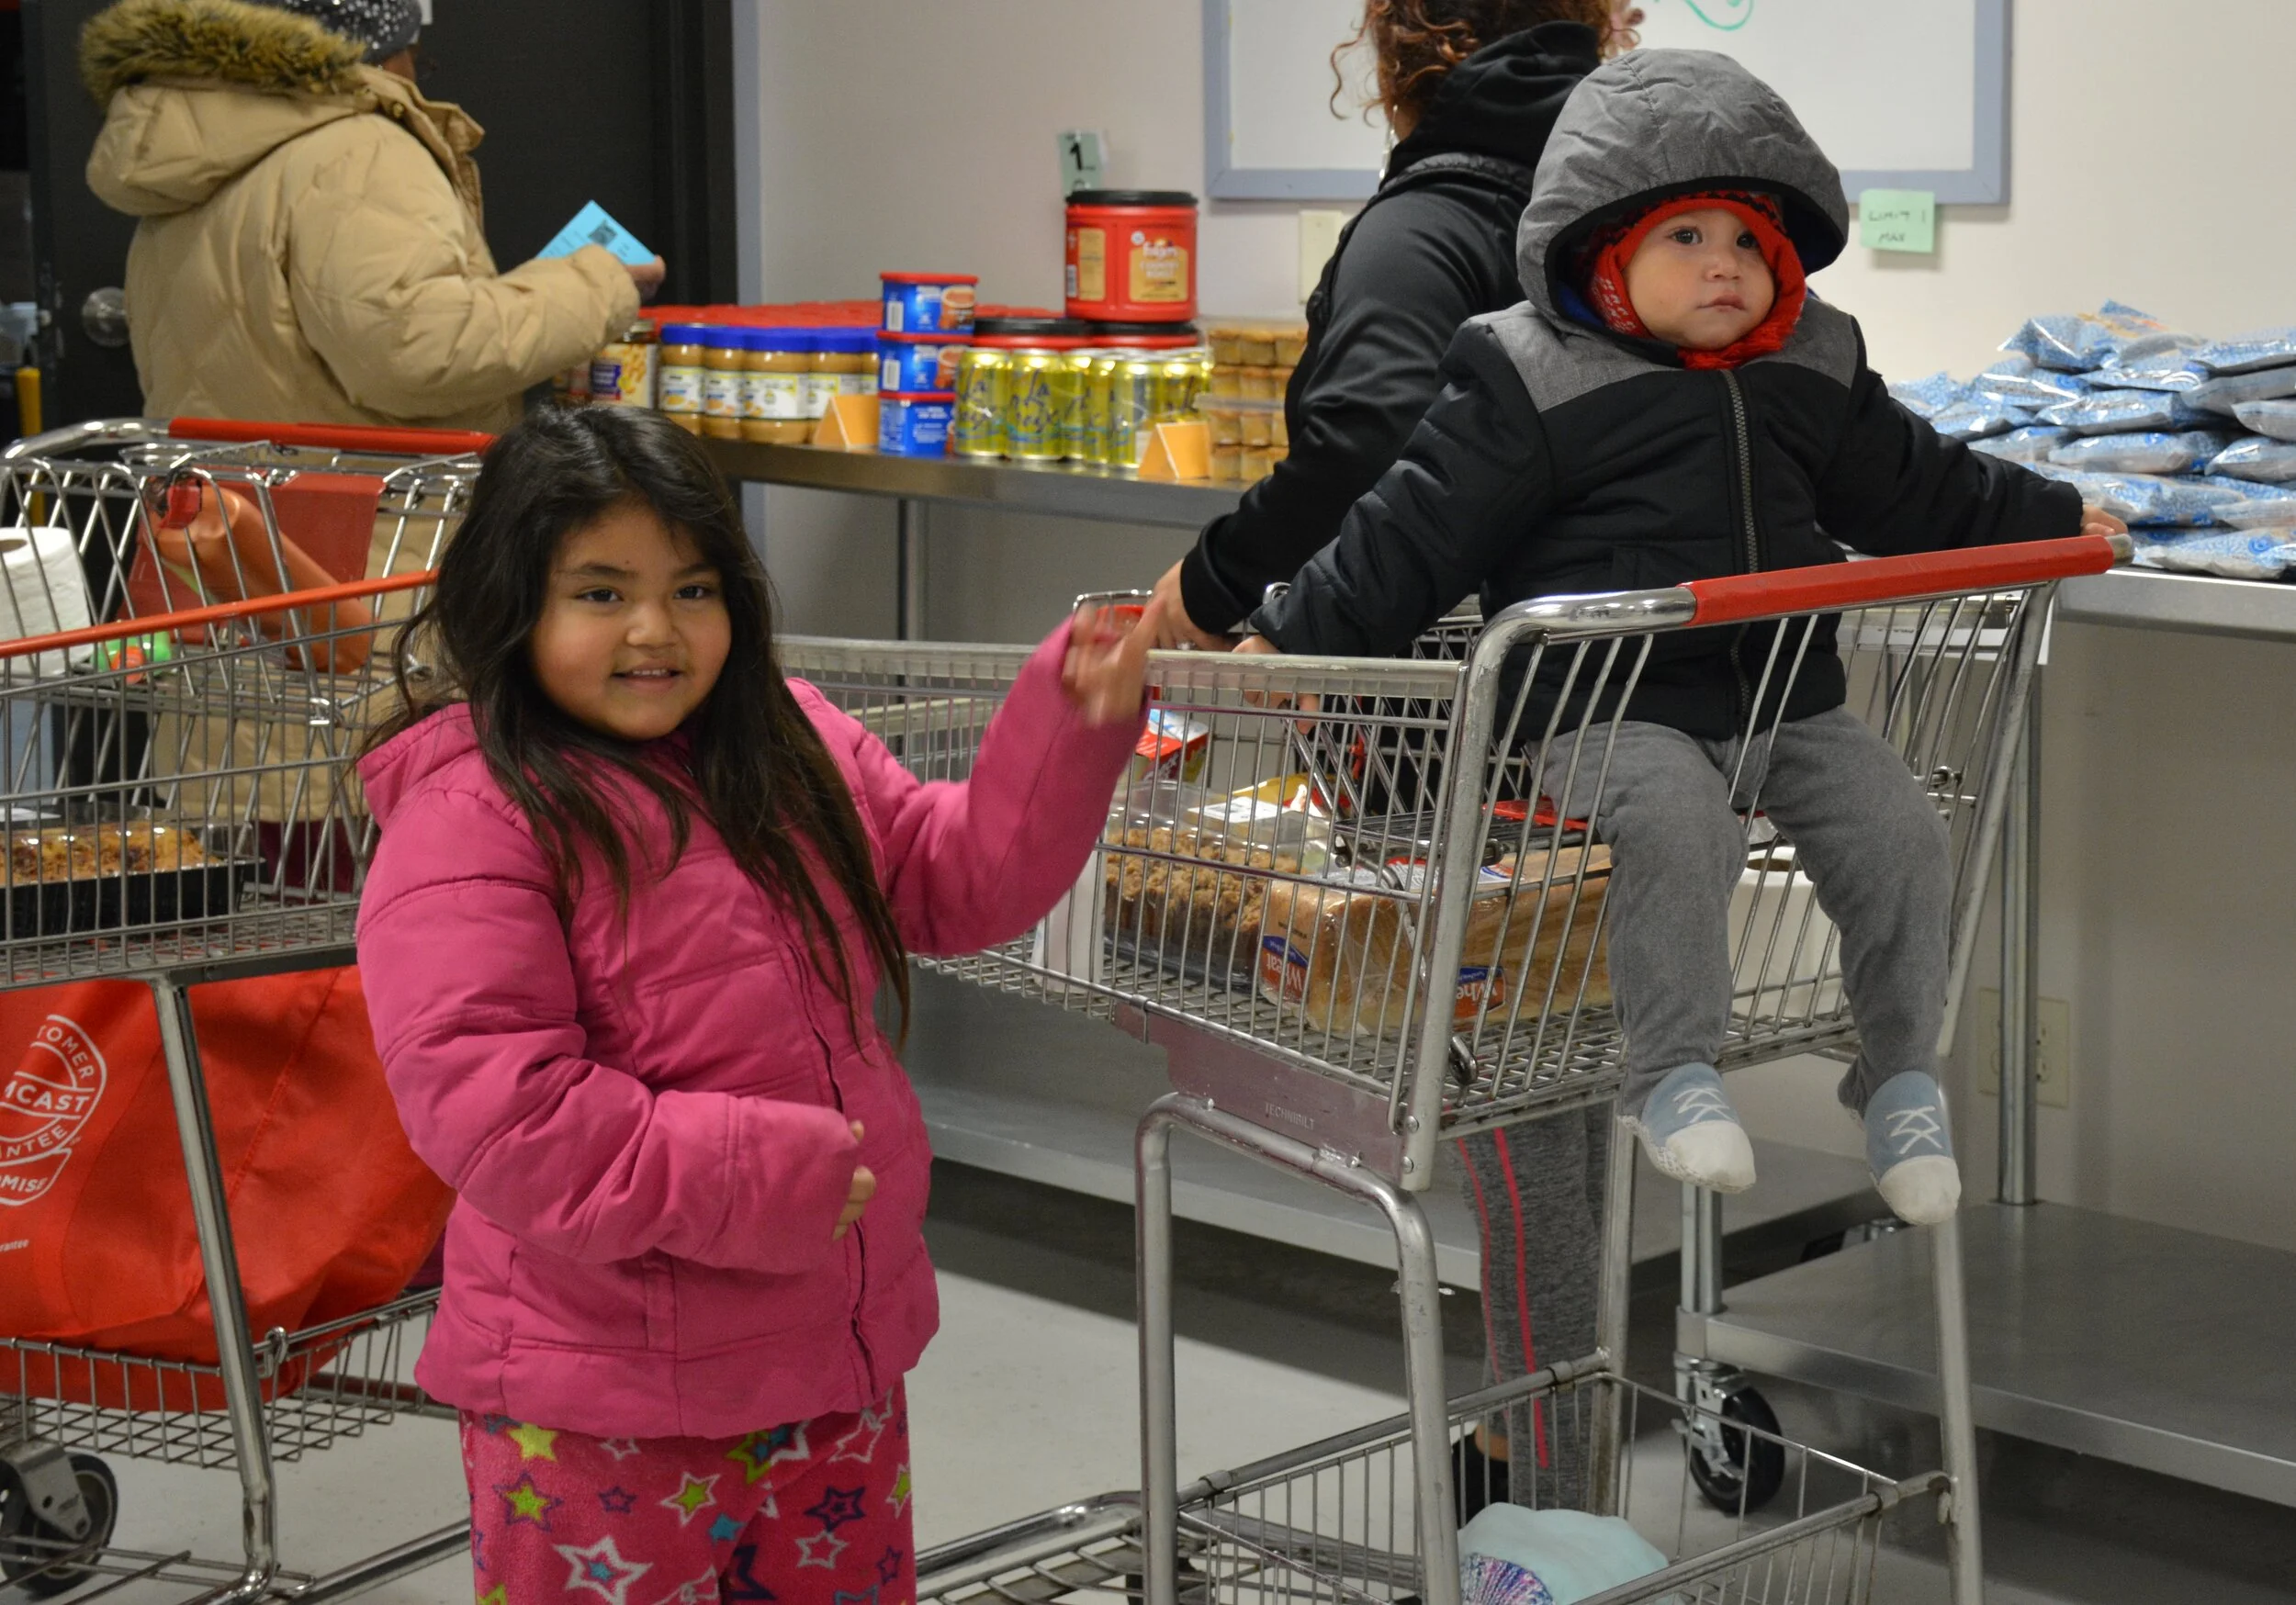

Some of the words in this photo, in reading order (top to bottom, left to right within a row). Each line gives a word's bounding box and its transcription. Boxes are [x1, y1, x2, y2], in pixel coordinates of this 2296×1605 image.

[1456, 983, 1498, 1001] Whe
[37, 1025, 95, 1079] TOMER
[5, 1080, 90, 1113] CAST
[1266, 1102, 1314, 1130] TECHNIBILT
[0, 1125, 68, 1158] NTEE
